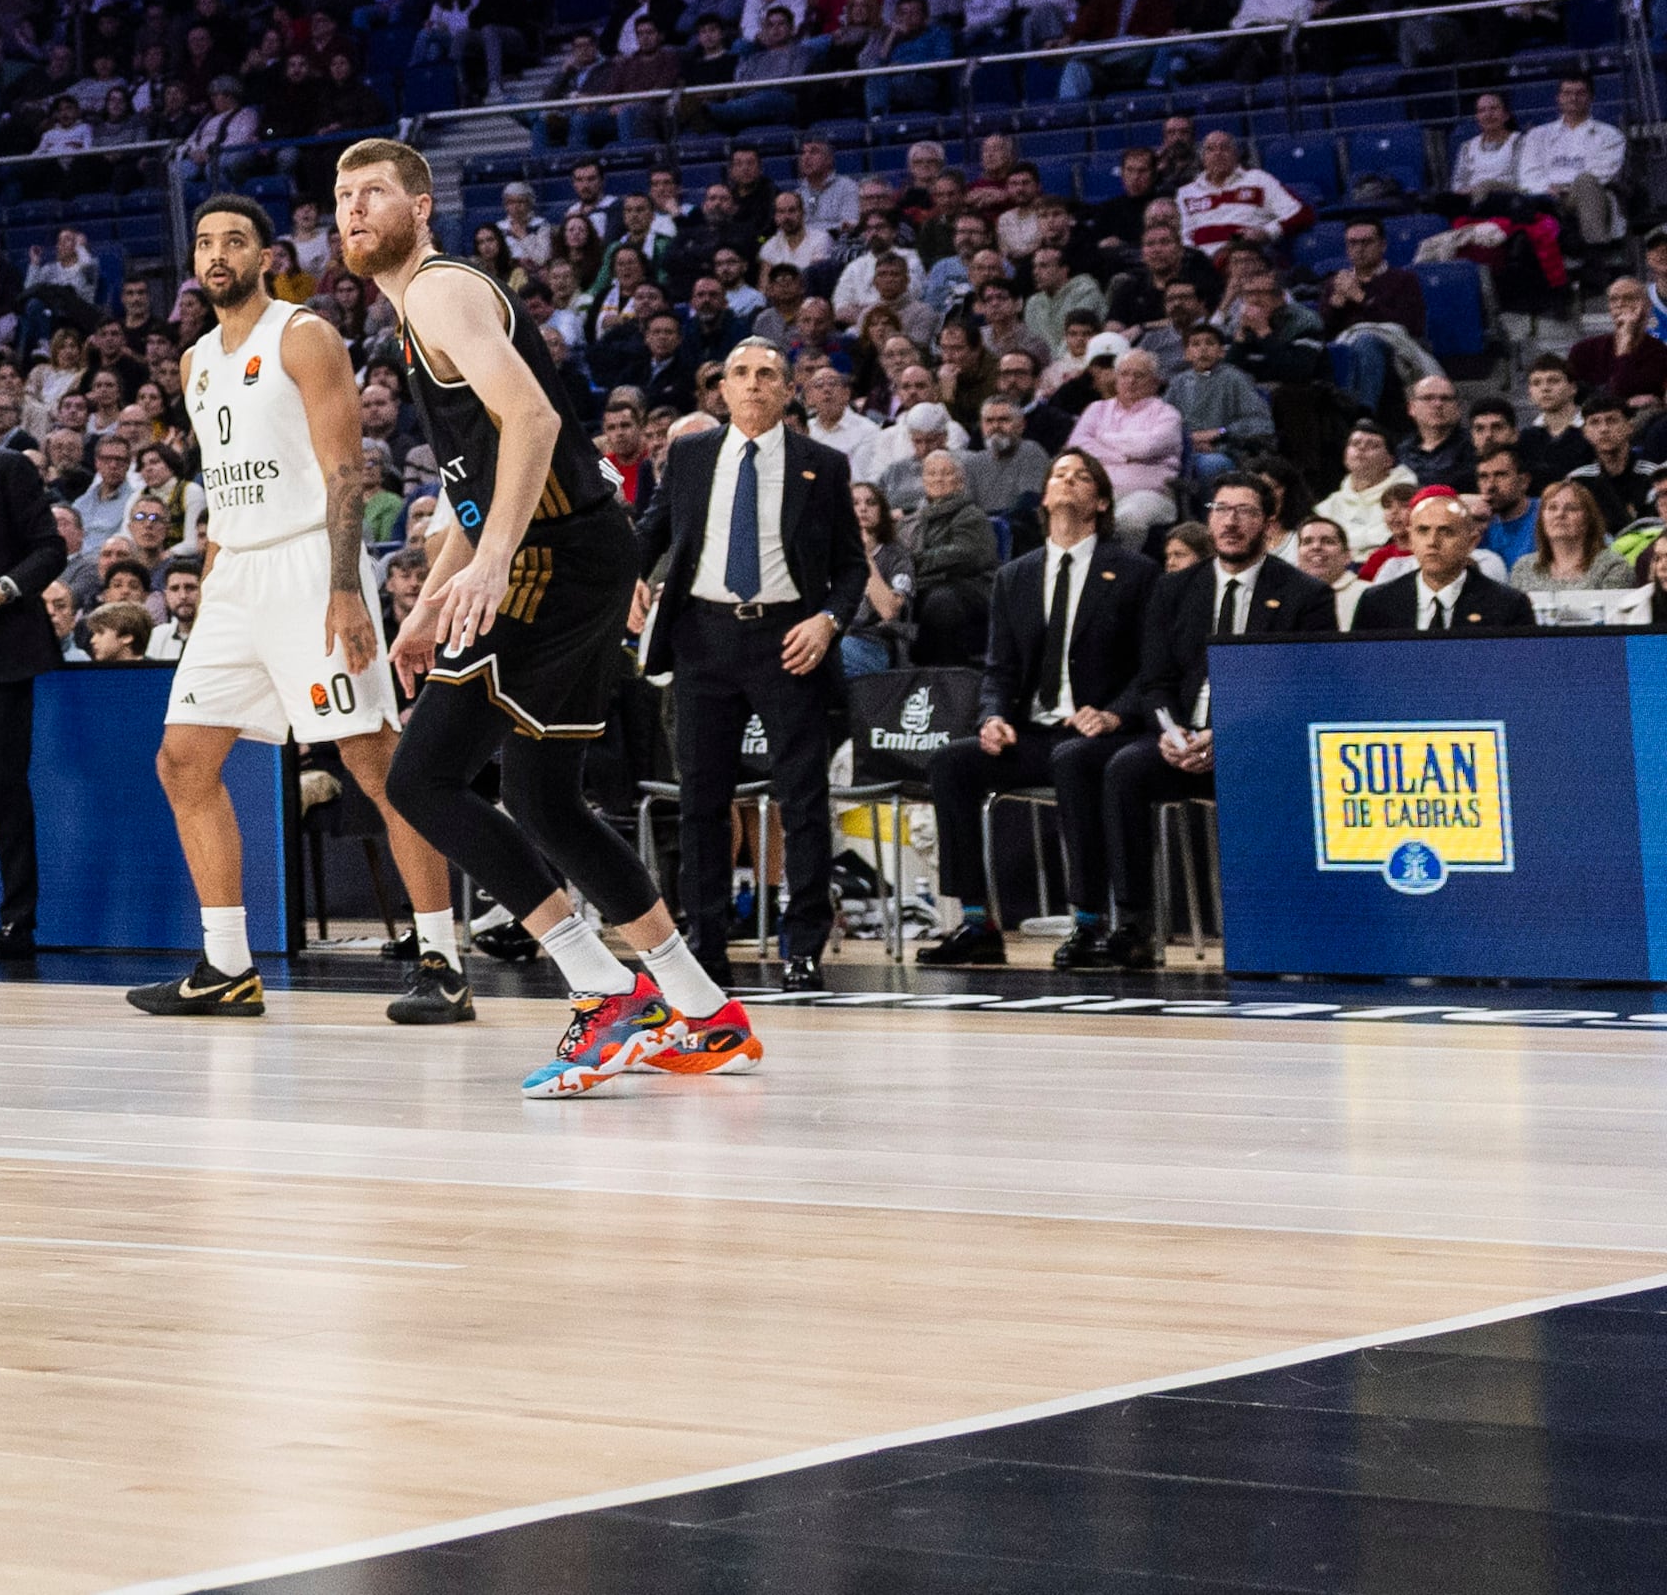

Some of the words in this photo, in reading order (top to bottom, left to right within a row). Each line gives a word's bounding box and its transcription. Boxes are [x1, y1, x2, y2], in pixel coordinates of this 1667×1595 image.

[870, 727, 951, 751] Emirates
[1339, 742, 1478, 795] SOLAN
[1342, 798, 1373, 828] DE
[1383, 798, 1482, 828] CABRAS
[723, 988, 1667, 1027] mirates
